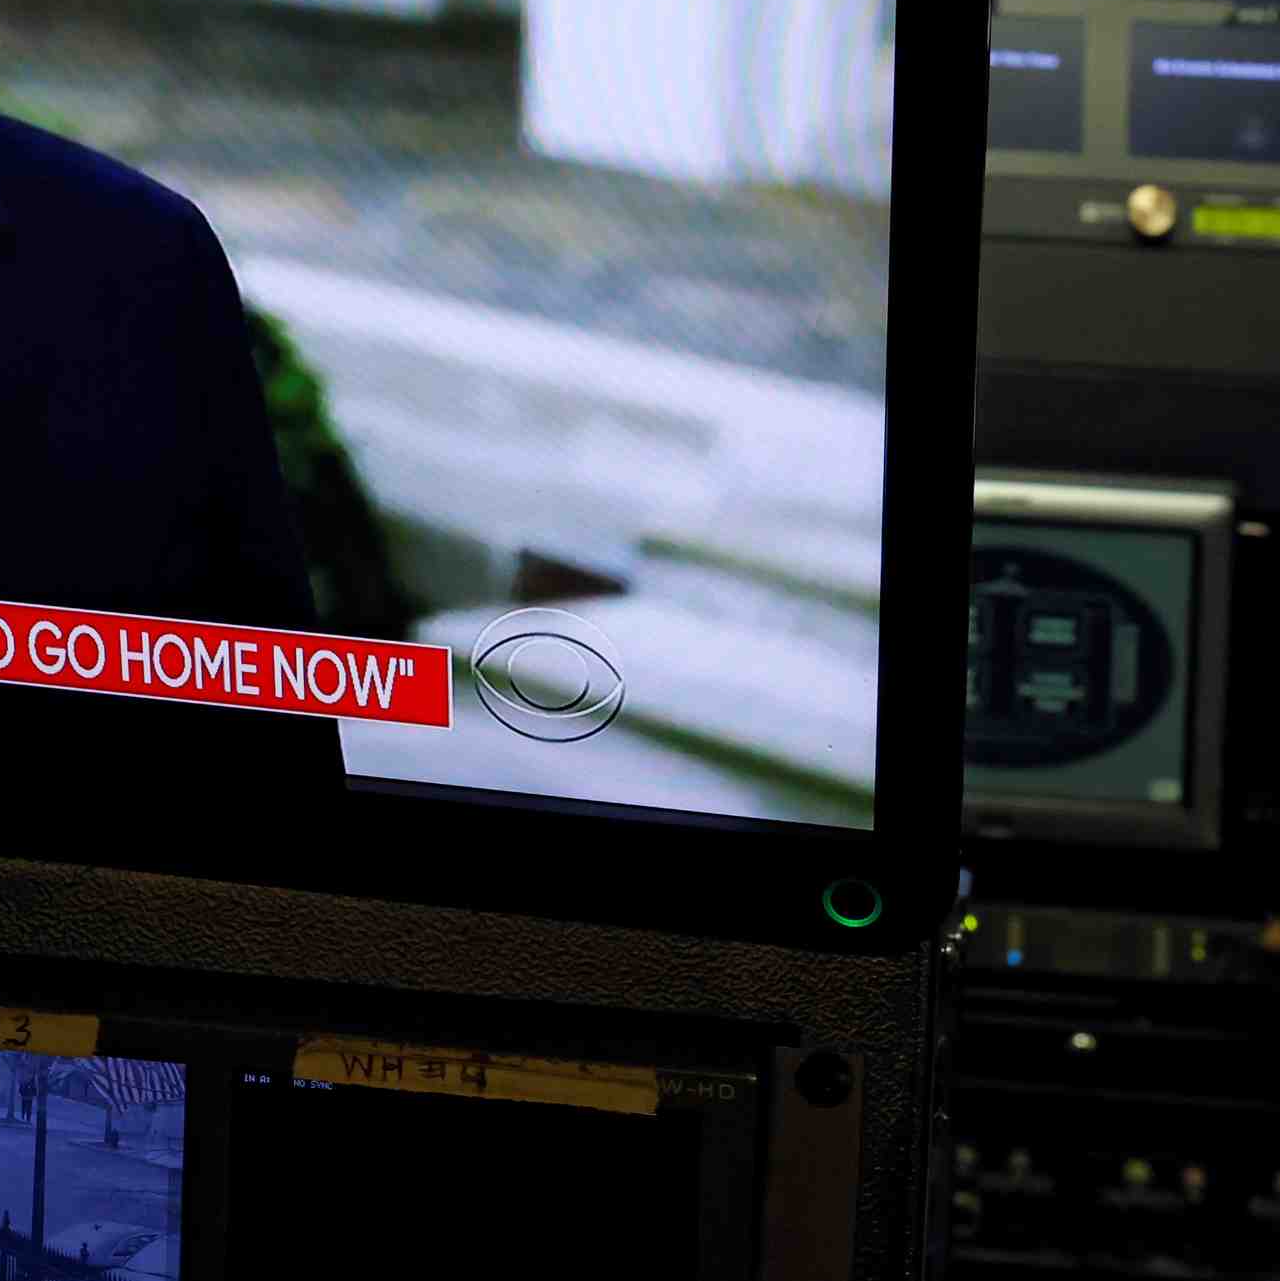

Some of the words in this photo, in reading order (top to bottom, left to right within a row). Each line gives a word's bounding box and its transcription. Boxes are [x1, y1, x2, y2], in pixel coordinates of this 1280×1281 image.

[28, 620, 106, 679] GO
[119, 629, 260, 696] HOME
[273, 645, 414, 709] NOW"
